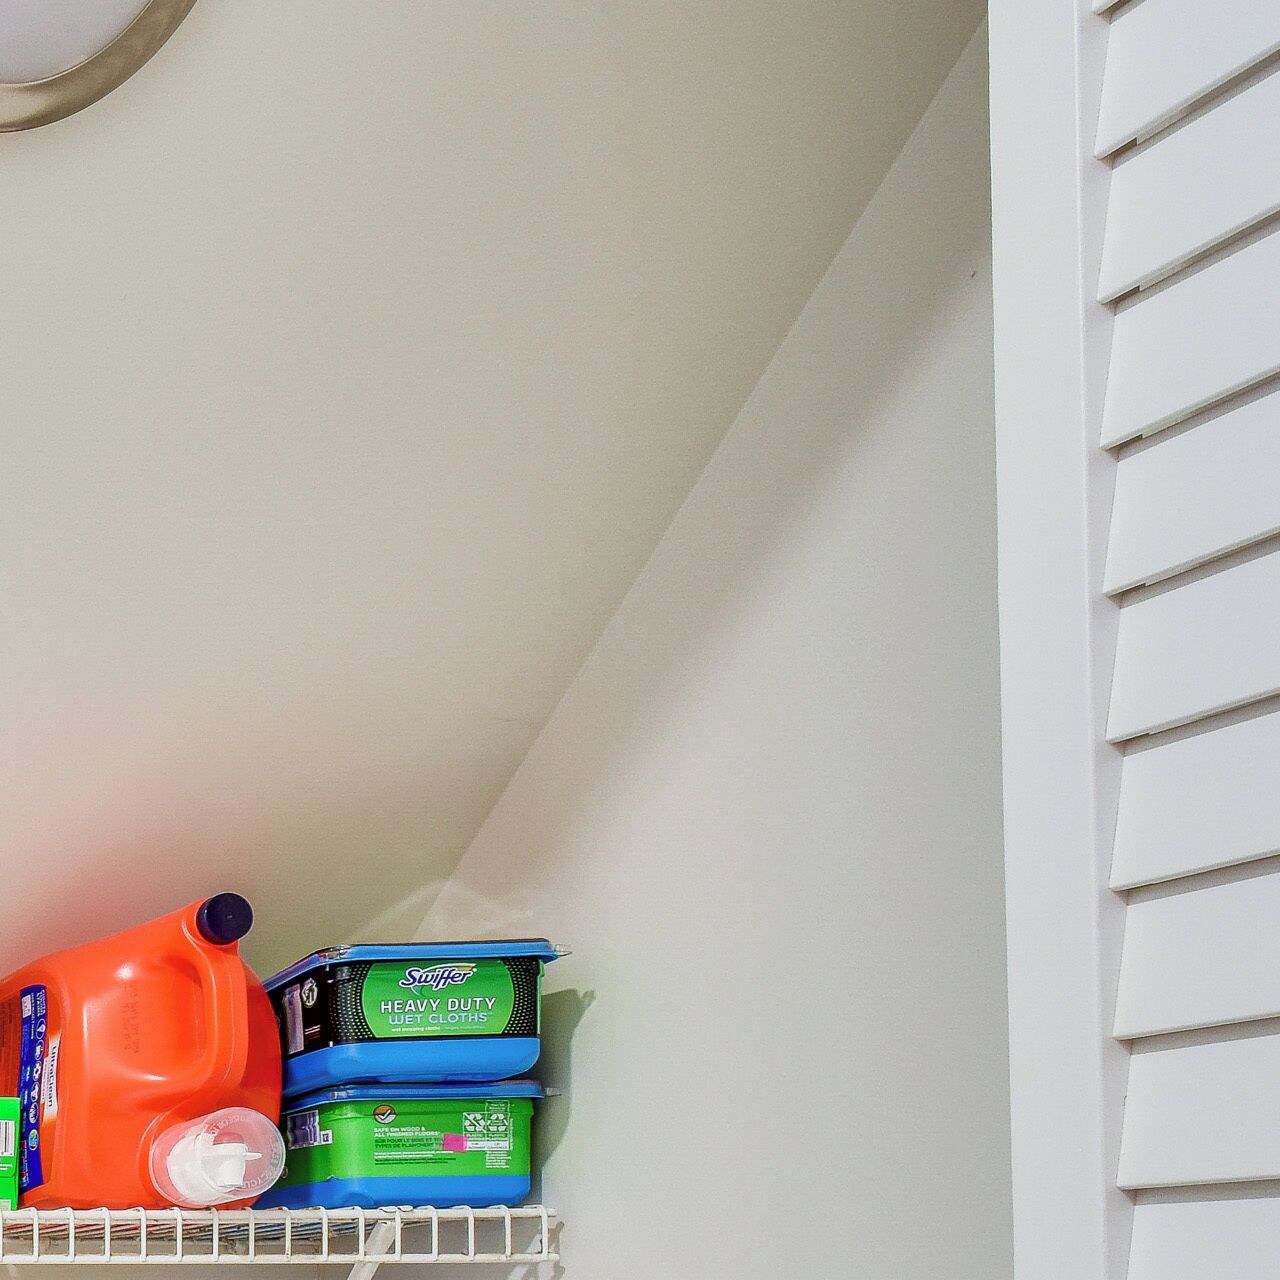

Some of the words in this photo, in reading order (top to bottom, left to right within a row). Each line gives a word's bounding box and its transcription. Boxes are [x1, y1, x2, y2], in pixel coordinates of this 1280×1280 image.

[400, 967, 472, 990] Swiffer
[381, 999, 440, 1013] HEAVY
[447, 997, 496, 1011] DUTY
[388, 1013, 423, 1025] WET
[428, 1012, 487, 1024] CLOTHS
